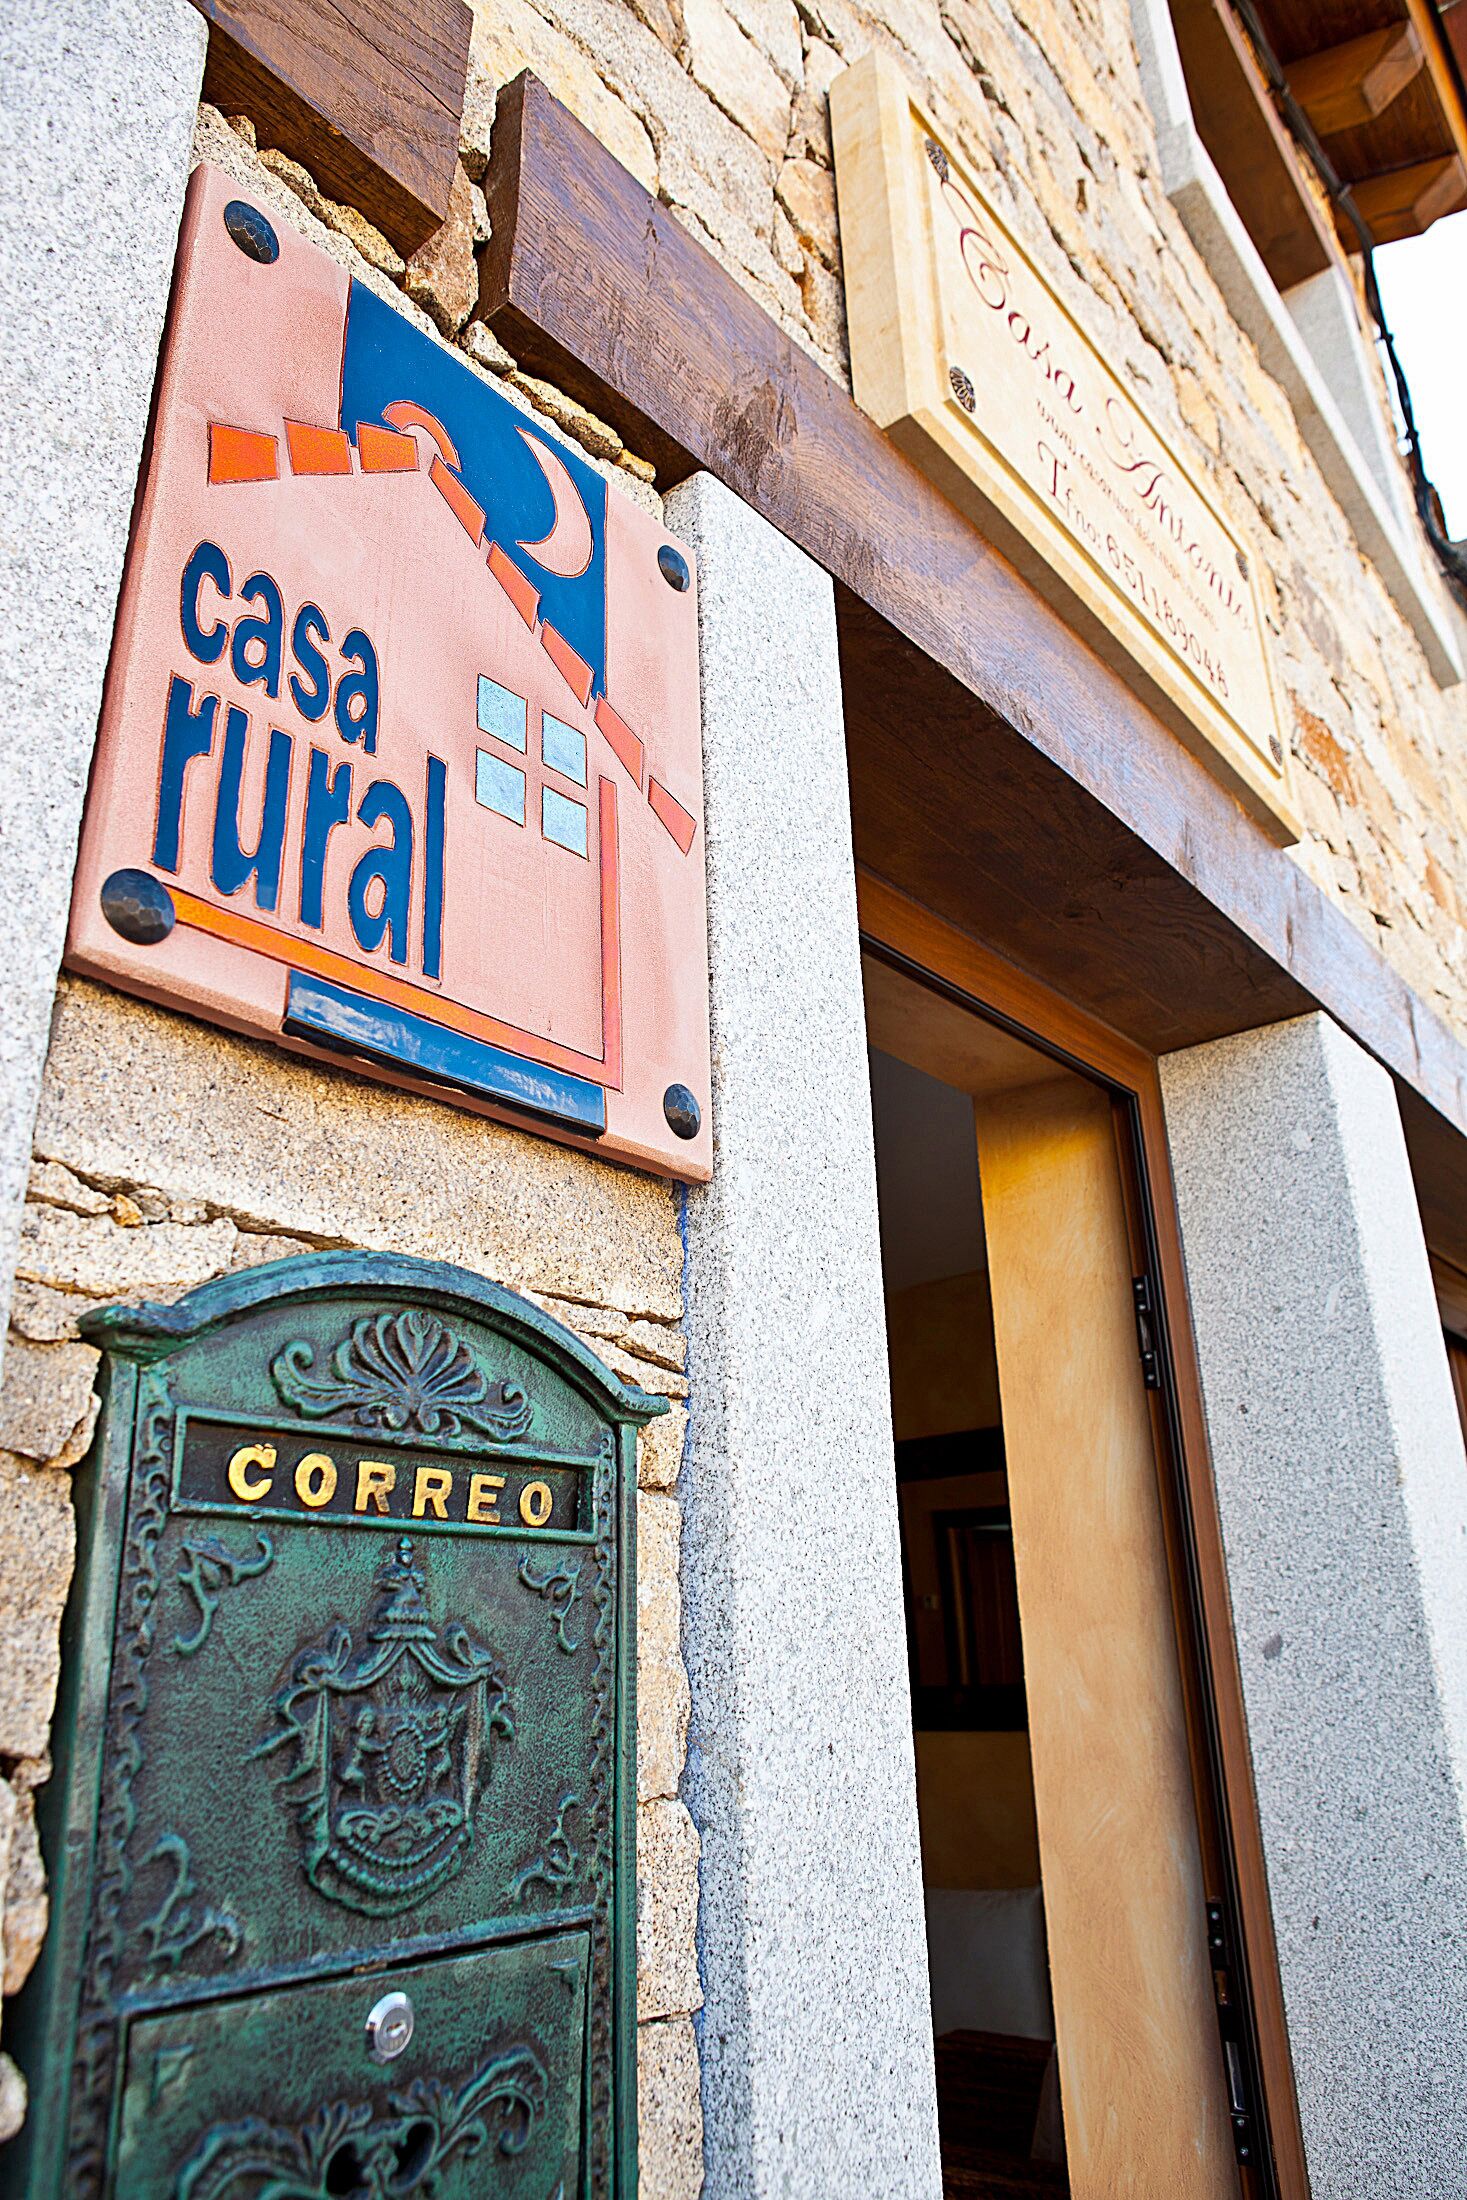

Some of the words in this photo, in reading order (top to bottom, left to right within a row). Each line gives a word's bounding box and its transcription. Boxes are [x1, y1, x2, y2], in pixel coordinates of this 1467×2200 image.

[941, 178, 1083, 414] Casa
[181, 540, 380, 754] casa
[151, 672, 447, 983] rural
[228, 1443, 553, 1527] CORREO
